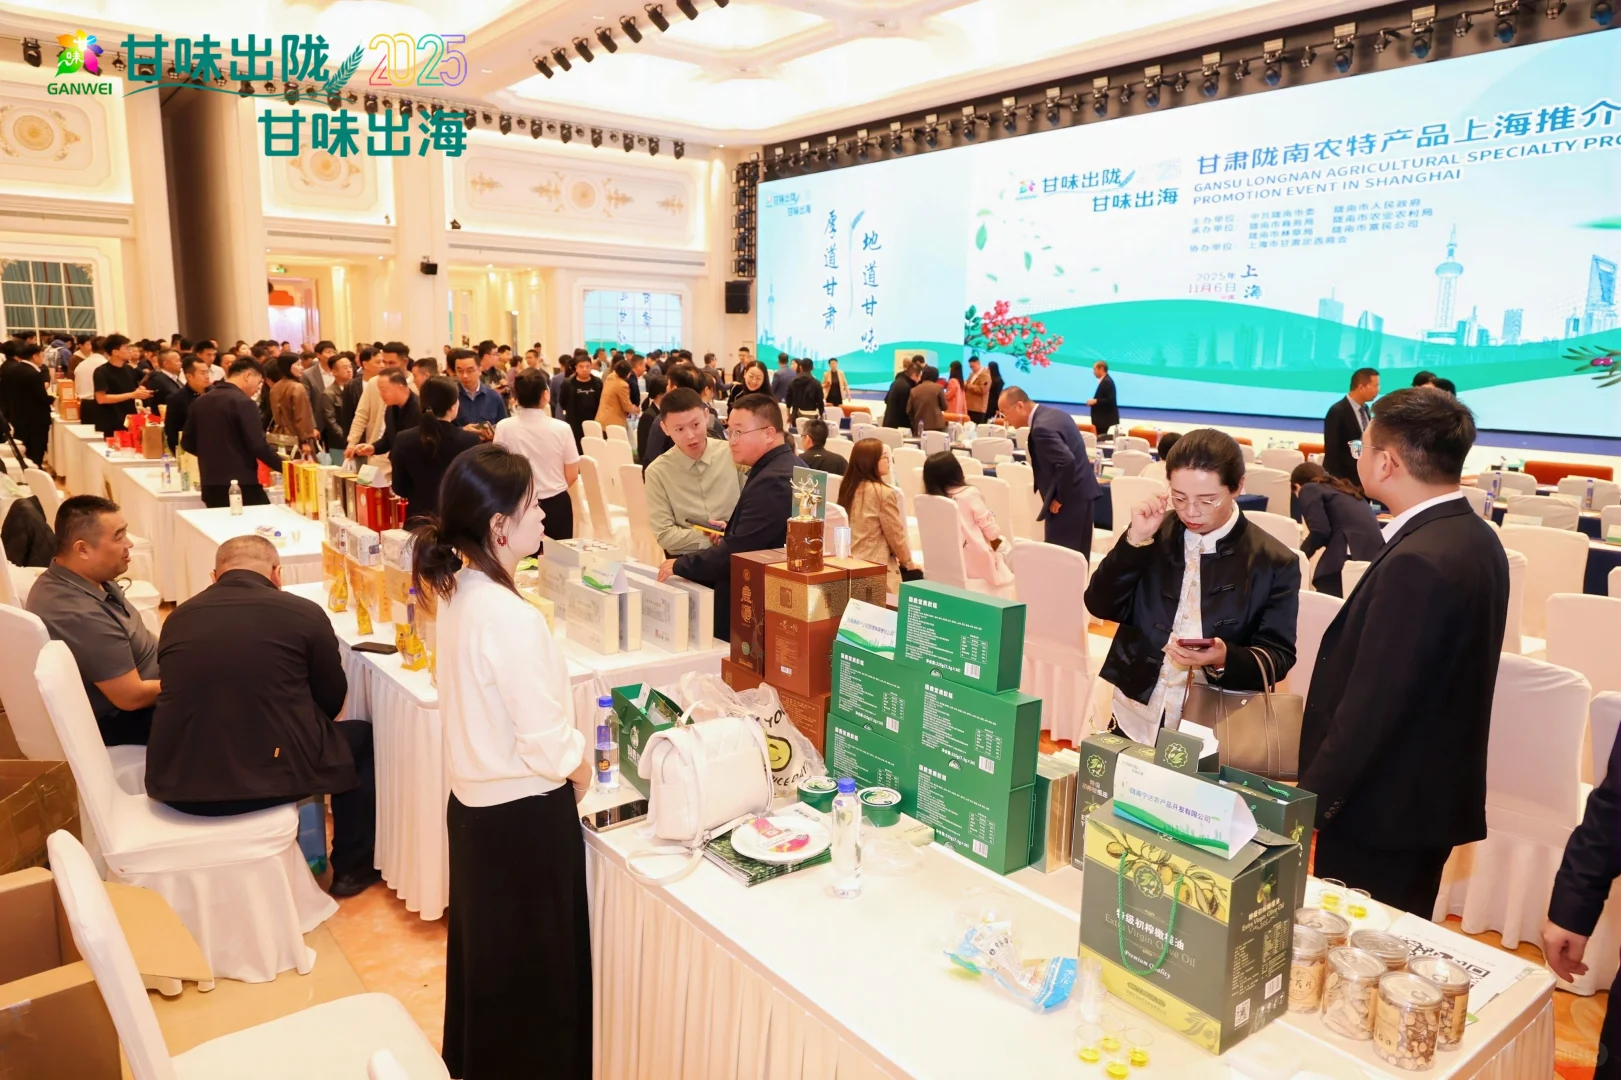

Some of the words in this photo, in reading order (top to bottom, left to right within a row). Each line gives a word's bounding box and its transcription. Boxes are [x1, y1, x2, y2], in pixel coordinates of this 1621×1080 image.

[1197, 99, 1621, 176] 甘肃陇南农特产品上海推介
[1042, 168, 1122, 193] 甘味出陇
[1194, 179, 1242, 193] GANSU
[1246, 169, 1322, 187] LONGNAN
[1326, 153, 1461, 179] AGRICULTURAL
[1467, 139, 1578, 163] SPECIALTY
[1092, 187, 1179, 212] 甘味出海
[1193, 187, 1282, 205] PROMOTION
[1286, 181, 1339, 196] EVENT
[1342, 179, 1360, 191] IN
[1365, 169, 1461, 188] SHANGHAI
[1127, 925, 1153, 945] Virgin
[1155, 940, 1180, 958] Oive
[1181, 953, 1196, 968] Oil
